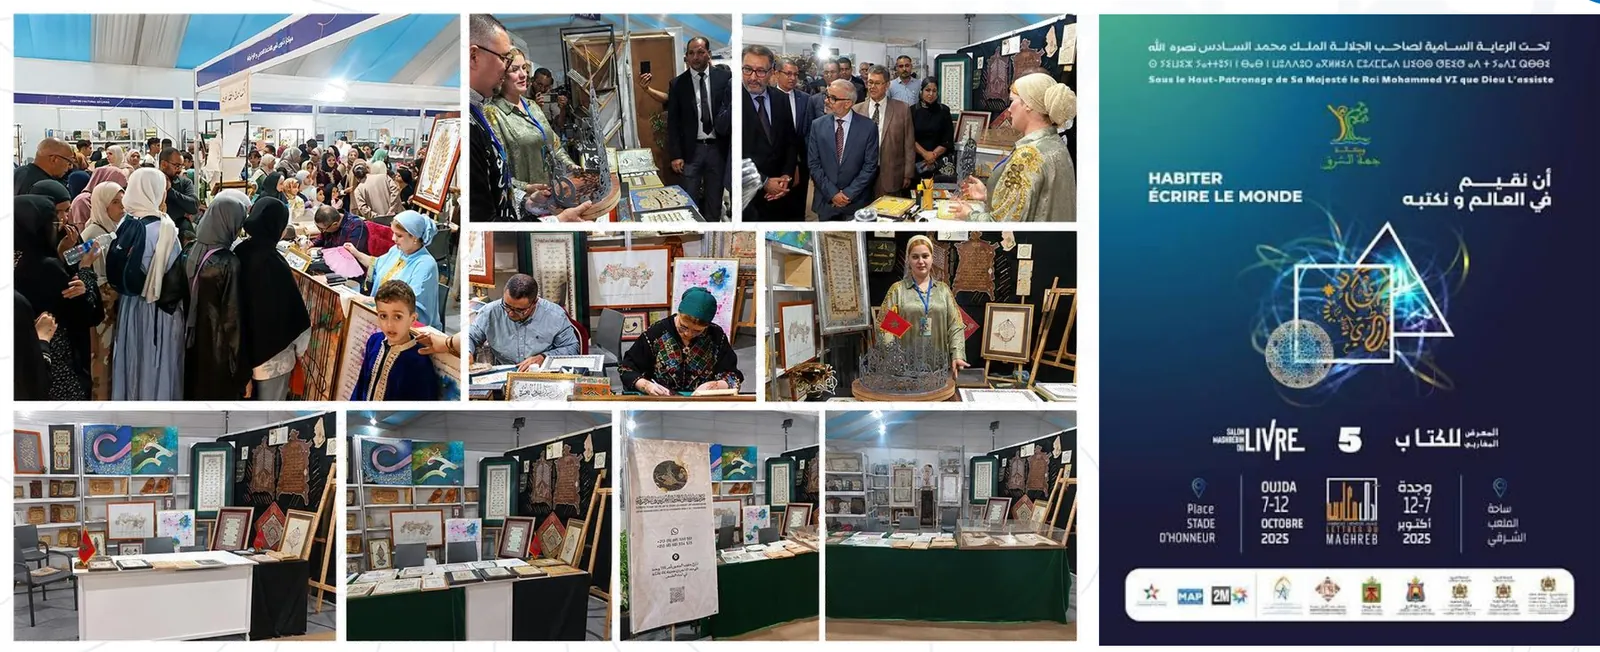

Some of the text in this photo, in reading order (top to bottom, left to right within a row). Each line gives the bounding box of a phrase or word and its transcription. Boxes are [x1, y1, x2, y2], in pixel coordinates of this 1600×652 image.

[1148, 39, 1166, 52] الله
[1169, 43, 1197, 54] نصره
[1198, 41, 1252, 53] السادس
[1289, 41, 1327, 51] الملك
[1329, 41, 1372, 53] الجلالة
[1374, 41, 1422, 53] لصاحب
[1425, 41, 1474, 53] السامية
[1476, 41, 1516, 53] الرعاية
[1519, 41, 1550, 51] تحت
[1148, 75, 1173, 84] Sous
[1175, 75, 1186, 84] le
[1188, 75, 1274, 86] Haut-Patronage
[1275, 75, 1288, 84] de
[1290, 75, 1303, 84] Sa
[1305, 75, 1348, 86] Majesté
[1350, 75, 1360, 84] le
[1362, 75, 1380, 84] Roi
[1381, 75, 1443, 84] Mohammed
[1444, 75, 1459, 84] VI
[1460, 76, 1480, 86] que
[1481, 75, 1506, 84] Dieu
[1148, 171, 1223, 185] HABITER
[1458, 167, 1552, 193] أن نقيم
[1148, 187, 1303, 203] ÉCRIRE LE MONDE
[1402, 191, 1552, 213] في العالم و نكتبه
[1226, 427, 1245, 436] SALON
[1245, 418, 1306, 461] LIVRE
[1337, 426, 1363, 454] 5
[1236, 444, 1245, 452] DU
[1261, 480, 1297, 493] OUJDA
[1397, 480, 1433, 497] وجدة
[1187, 503, 1215, 515] Place
[1261, 495, 1290, 513] 7-12
[1487, 502, 1512, 514] ساحة
[1187, 518, 1216, 529] STADE
[1261, 518, 1304, 529] OCTOBRE
[1397, 517, 1432, 532] أكتوبر
[1487, 518, 1519, 531] الملعب
[1261, 533, 1289, 544] 2025
[1326, 533, 1378, 545] MAGHREB
[1403, 533, 1432, 544] 2025
[1487, 530, 1527, 547] الشرقي
[1178, 592, 1203, 602] MAP
[1213, 588, 1230, 604] 2M
